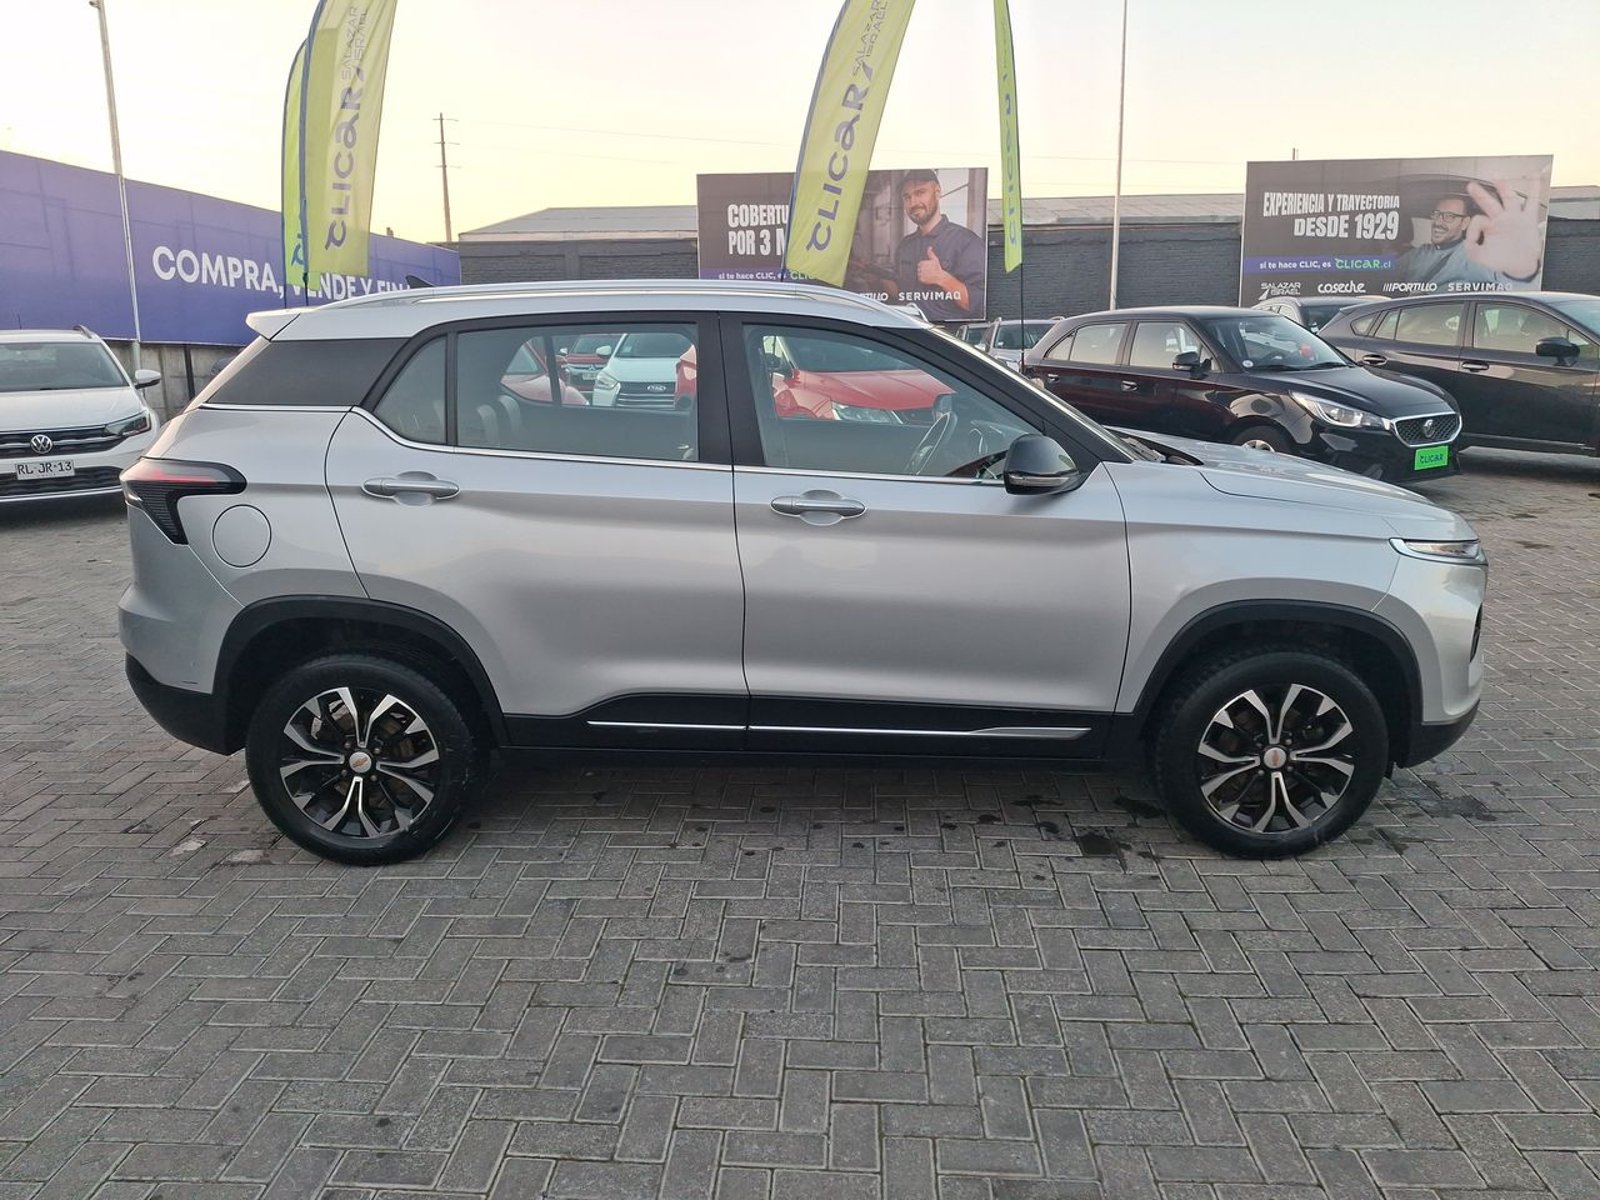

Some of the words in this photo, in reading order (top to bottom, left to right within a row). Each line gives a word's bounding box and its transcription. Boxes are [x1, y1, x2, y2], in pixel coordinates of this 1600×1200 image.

[341, 6, 358, 80] SALAZAR
[1263, 192, 1325, 217] EXPERIENCIA
[1327, 193, 1335, 212] Y
[1336, 194, 1400, 212] TRAYECTORIA
[1294, 215, 1350, 238] DESDE
[1354, 211, 1400, 240] 1929
[728, 230, 756, 256] POR
[760, 229, 771, 256] 3
[152, 246, 285, 299] COMPRA,
[360, 277, 372, 295] Y
[735, 272, 754, 280] hace
[1259, 261, 1267, 269] si
[1268, 261, 1277, 269] te
[1278, 261, 1298, 269] hace
[1299, 260, 1320, 269] CLIC,
[898, 291, 961, 301] SERVIMAQ
[1317, 280, 1367, 293] coseche
